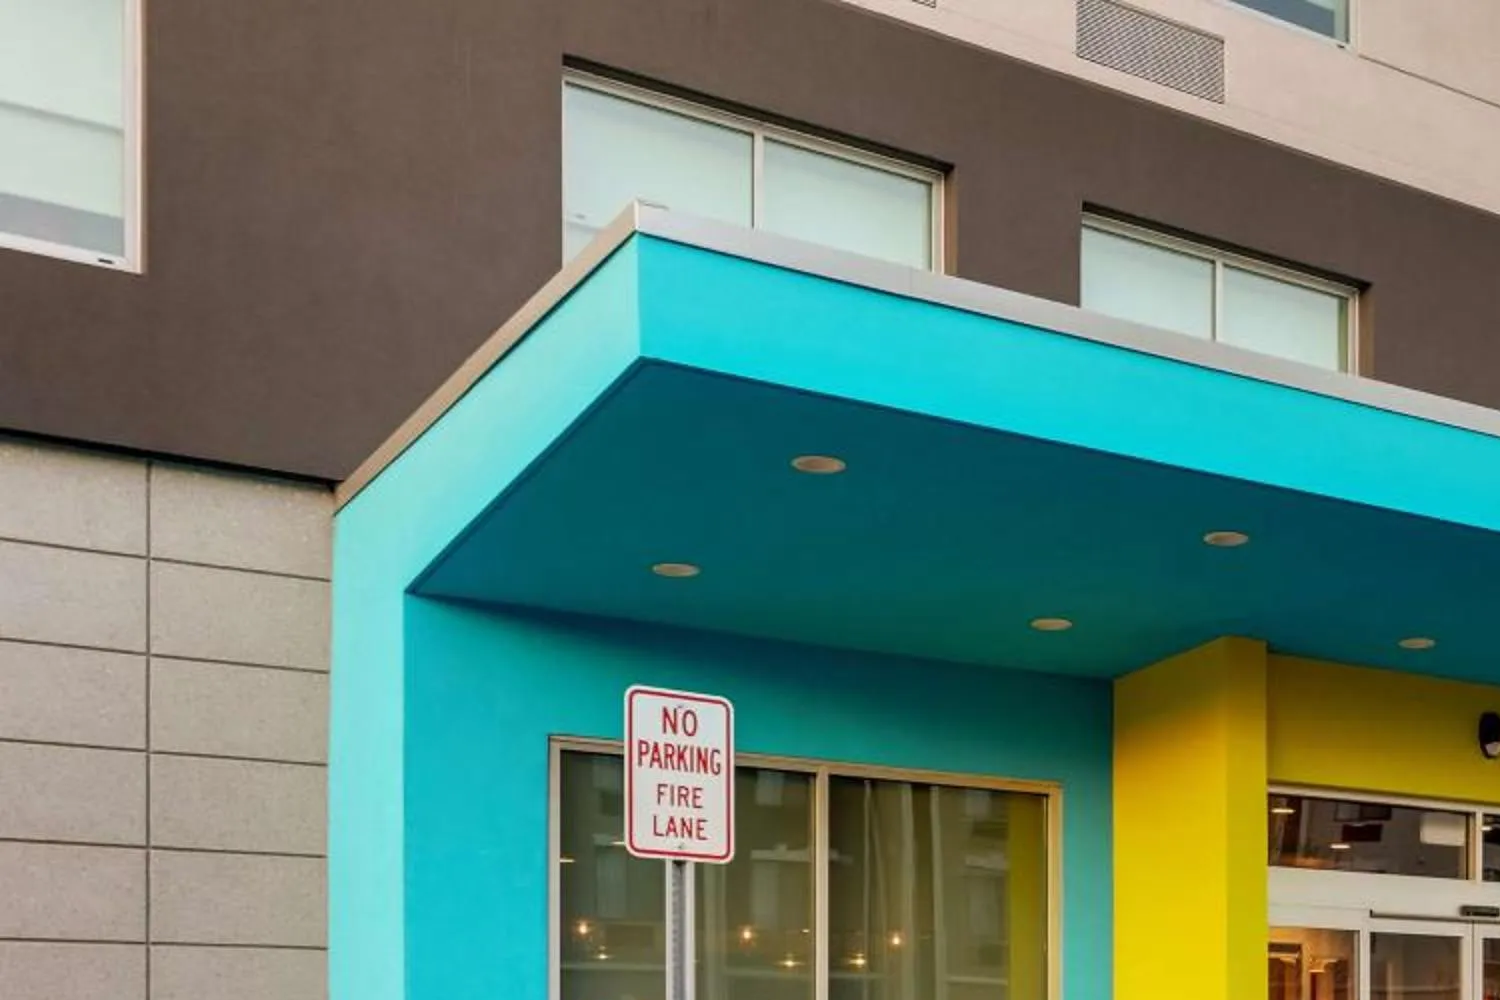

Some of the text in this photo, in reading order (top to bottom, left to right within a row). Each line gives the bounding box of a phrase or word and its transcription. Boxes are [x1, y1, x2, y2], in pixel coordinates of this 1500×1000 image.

[661, 706, 698, 737] NO
[637, 739, 721, 776] PARKING
[656, 783, 704, 809] FIRE
[652, 815, 708, 841] LANE
